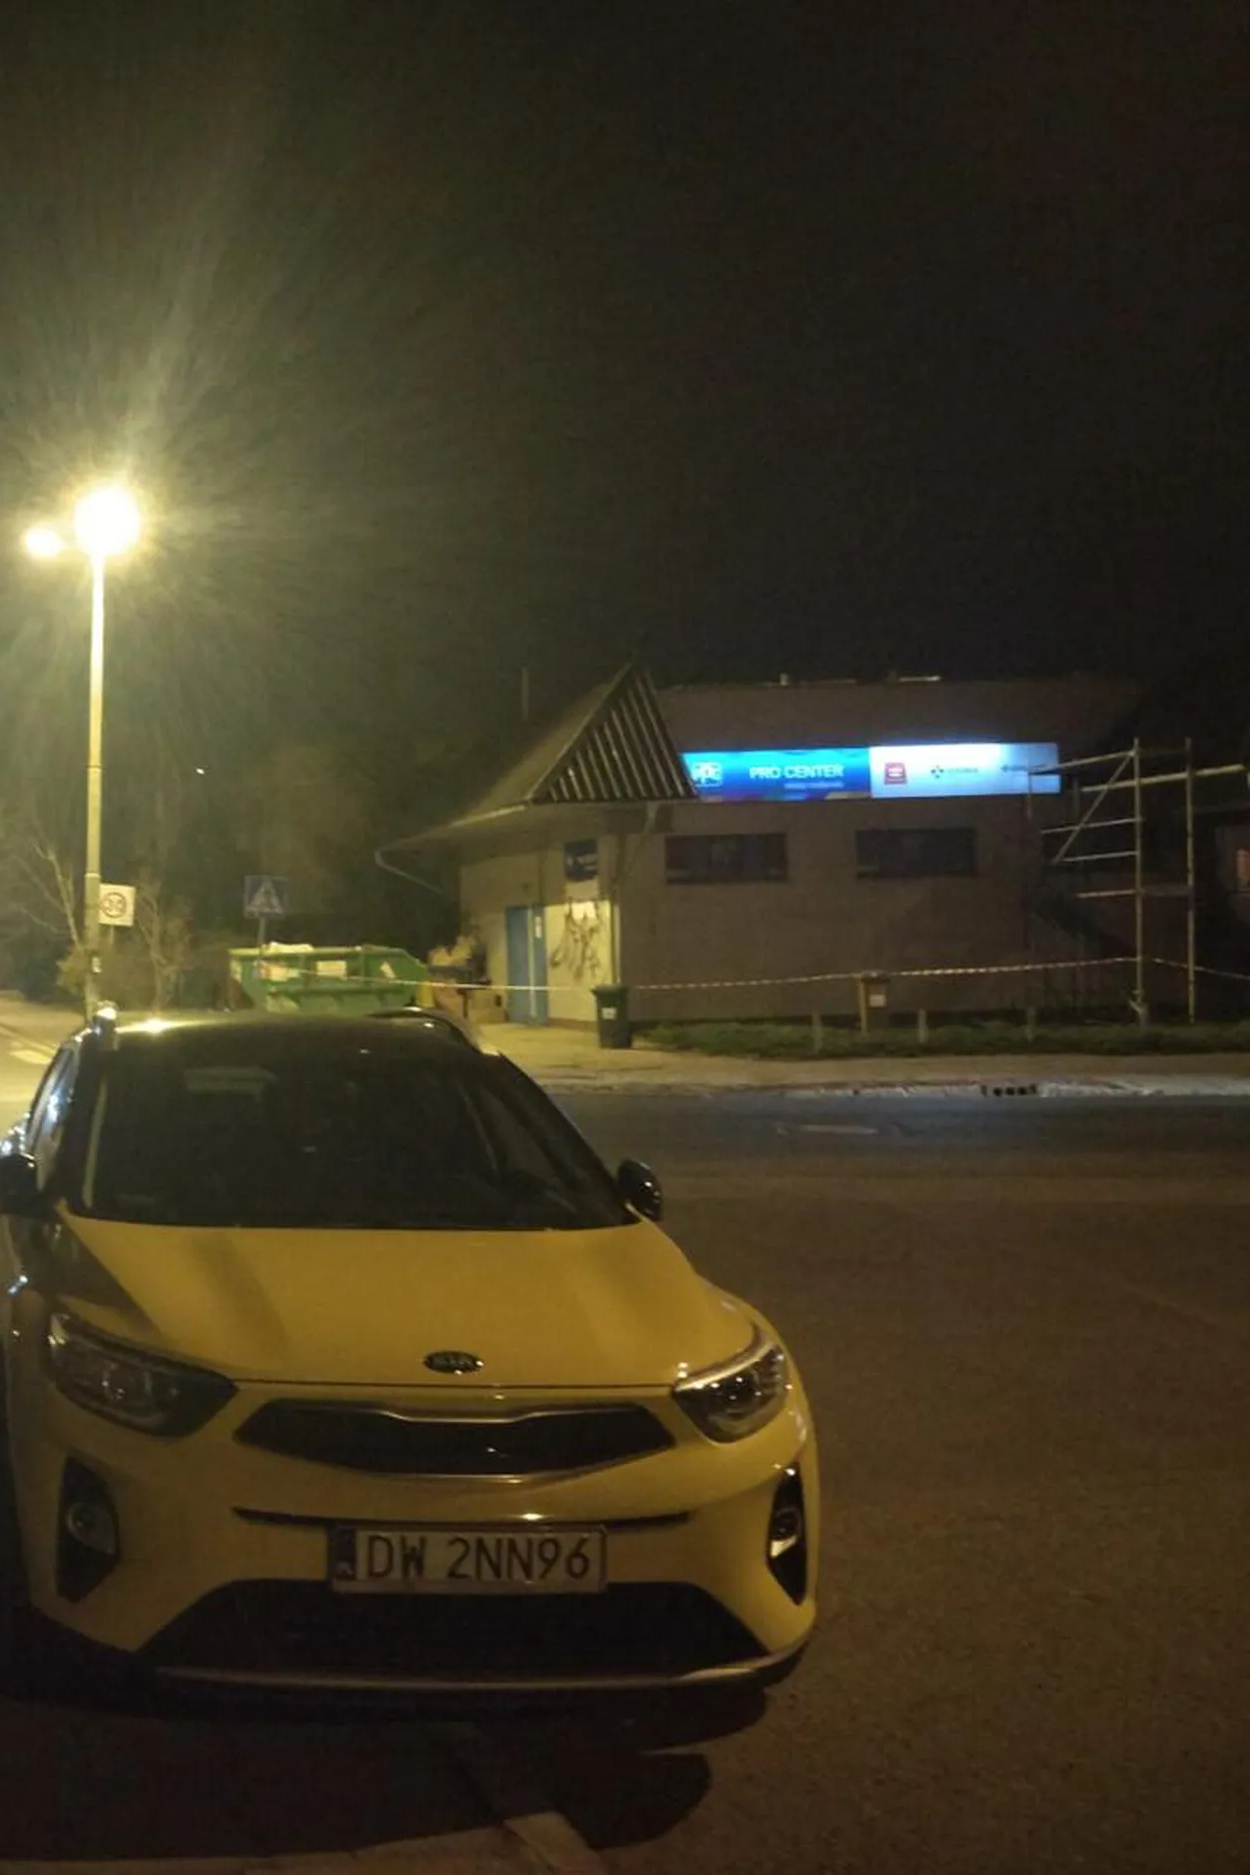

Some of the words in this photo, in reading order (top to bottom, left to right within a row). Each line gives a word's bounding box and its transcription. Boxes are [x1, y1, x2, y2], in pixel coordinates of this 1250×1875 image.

[749, 766, 781, 779] PRO
[784, 764, 845, 778] CENTER
[367, 1535, 427, 1579] DW
[446, 1536, 590, 1580] 2NN96
